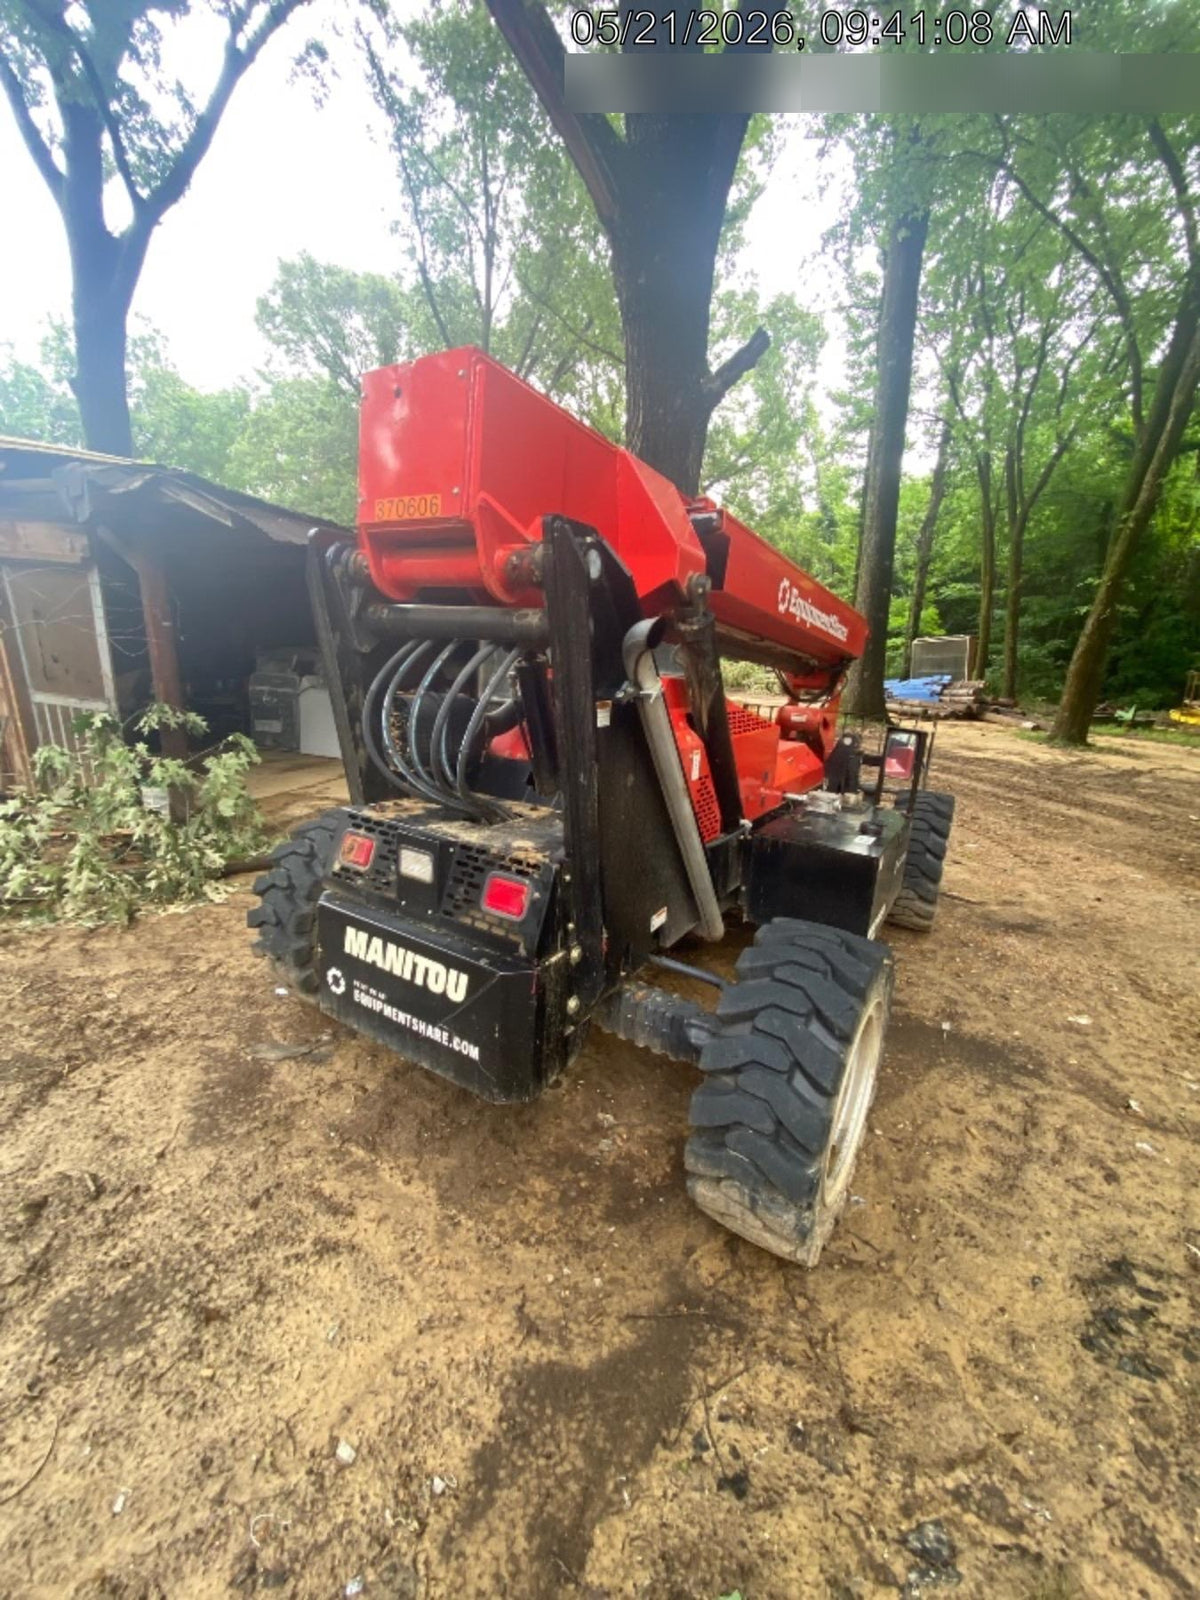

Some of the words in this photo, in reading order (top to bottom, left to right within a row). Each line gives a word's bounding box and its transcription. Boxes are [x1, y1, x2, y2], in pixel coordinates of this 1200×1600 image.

[376, 495, 439, 519] 370606
[344, 926, 469, 1003] MANITOU
[353, 990, 480, 1061] EQUIPMENTSHARE.COM
